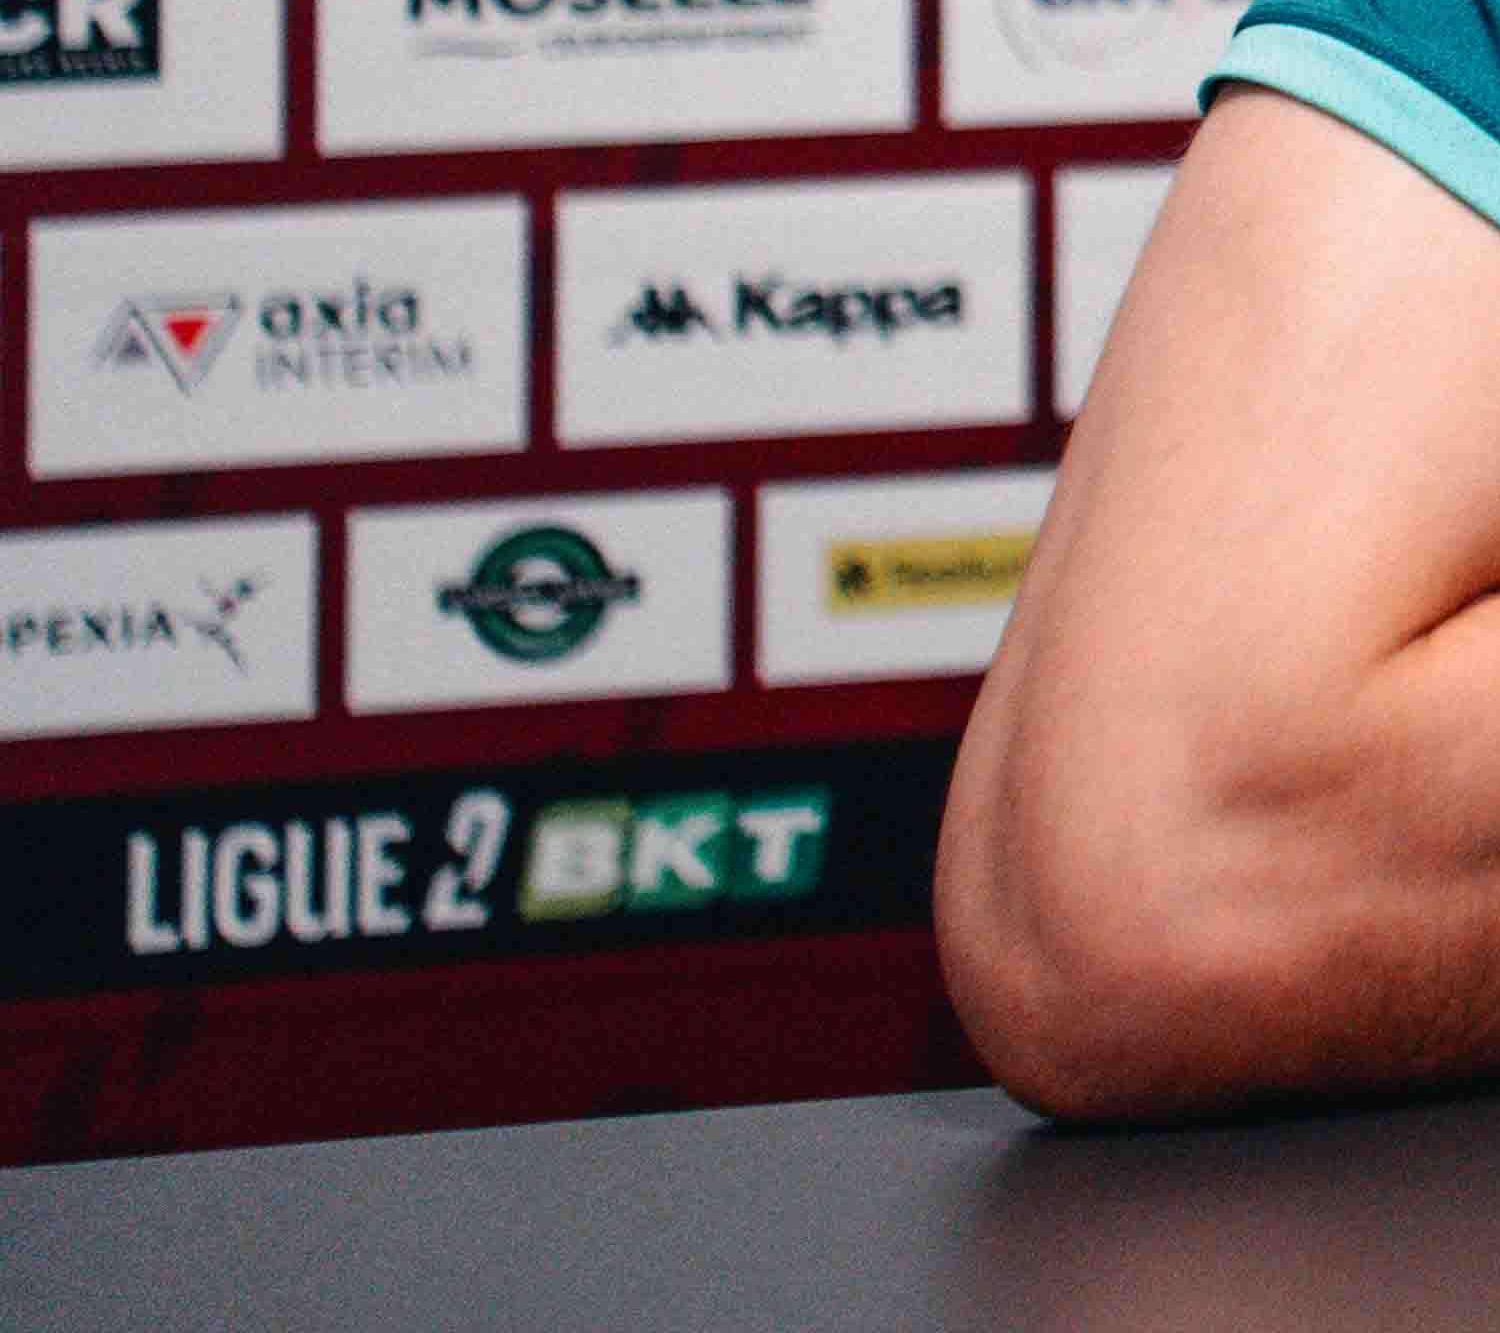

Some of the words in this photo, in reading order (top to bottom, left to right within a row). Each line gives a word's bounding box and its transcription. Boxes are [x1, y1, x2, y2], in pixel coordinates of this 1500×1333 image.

[259, 283, 419, 340] axia
[733, 280, 964, 340] Kappa
[256, 333, 472, 386] INTERIM
[0, 606, 176, 654] PEXIA
[128, 817, 407, 952] LIGUE
[425, 794, 506, 928] 2
[528, 803, 824, 901] BKT
